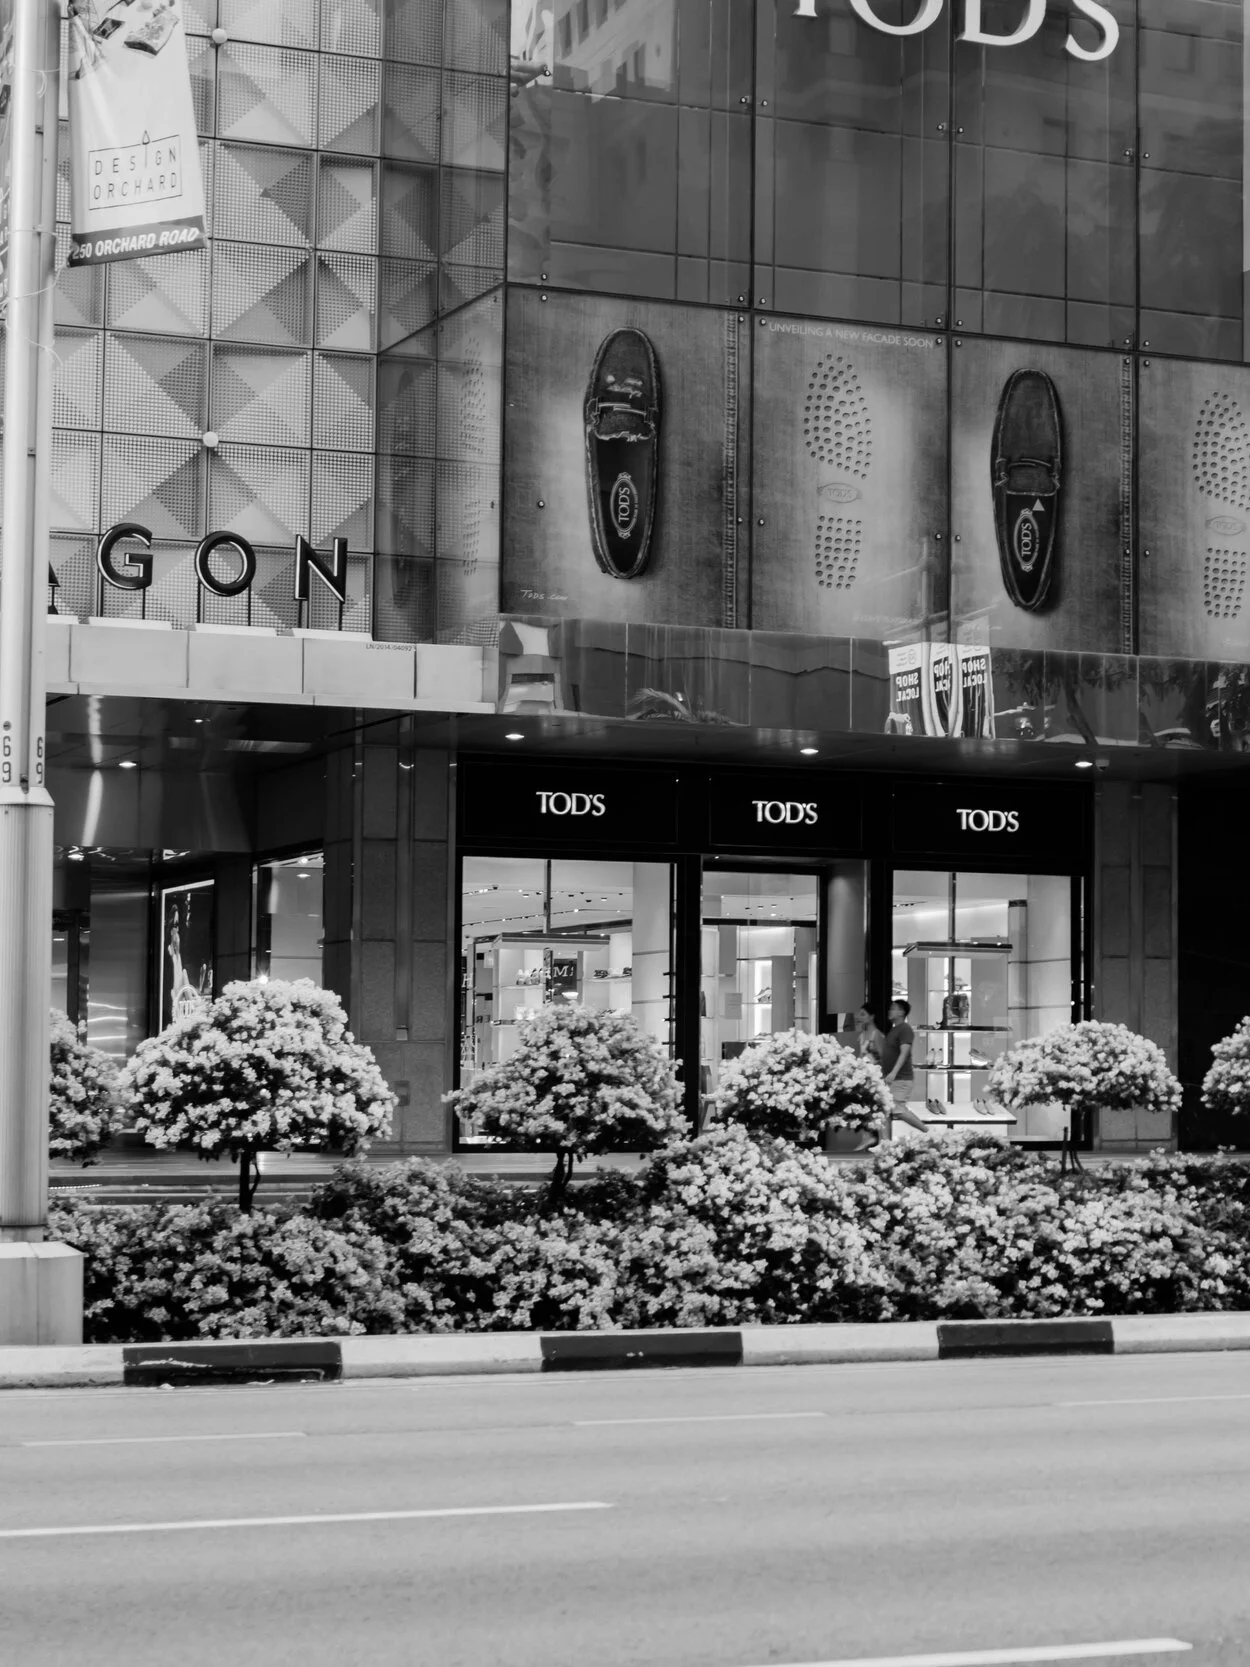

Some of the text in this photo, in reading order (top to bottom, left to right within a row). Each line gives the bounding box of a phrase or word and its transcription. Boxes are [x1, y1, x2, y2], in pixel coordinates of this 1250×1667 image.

[94, 145, 177, 175] DESIGN
[93, 172, 177, 200] ORCHARD
[72, 227, 200, 259] 250 ORCHARD ROAD
[769, 323, 824, 337] UNVEILING
[825, 328, 833, 337] A
[836, 330, 860, 341] NEW
[903, 337, 934, 349] SOON
[49, 522, 348, 604] GON
[536, 792, 605, 816] TOD'S
[752, 801, 818, 824] TOD'S
[956, 809, 1019, 832] TOD'S
